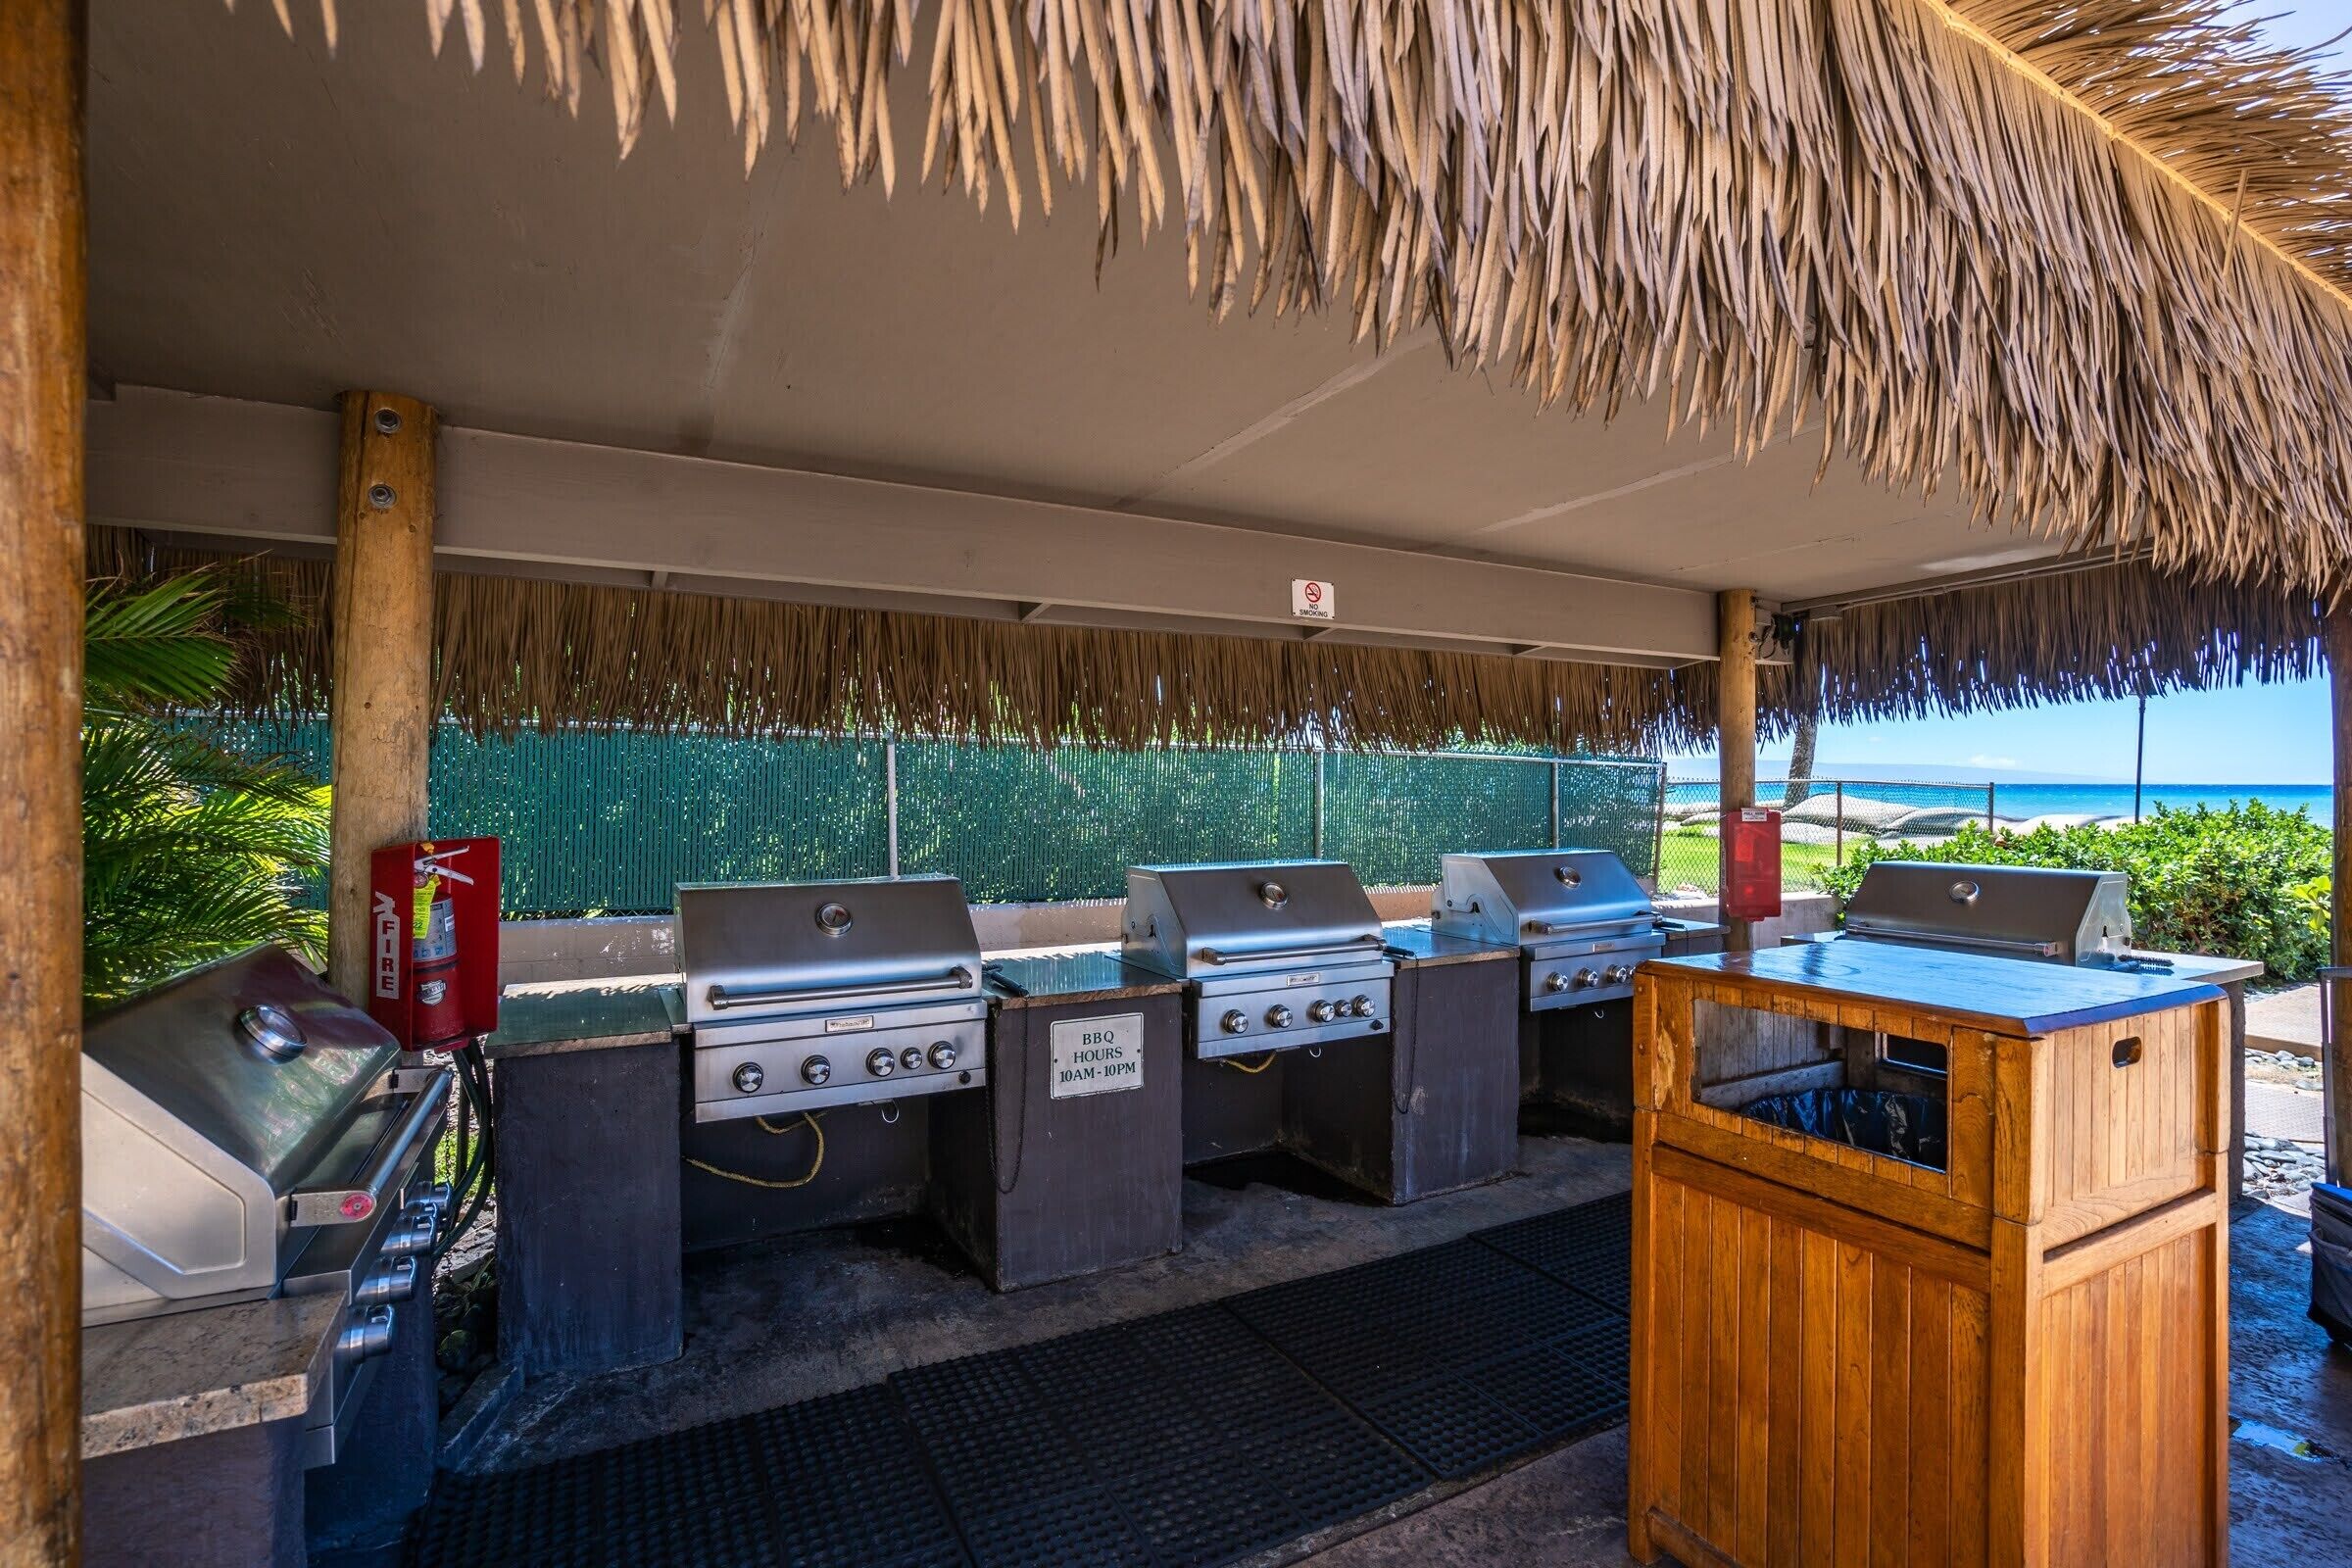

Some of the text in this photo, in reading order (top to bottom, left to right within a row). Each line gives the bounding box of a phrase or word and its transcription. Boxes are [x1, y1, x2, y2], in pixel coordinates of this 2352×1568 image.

[382, 920, 394, 991] FIRE
[1083, 1031, 1114, 1045] BBQ
[1074, 1047, 1123, 1063] HOURS
